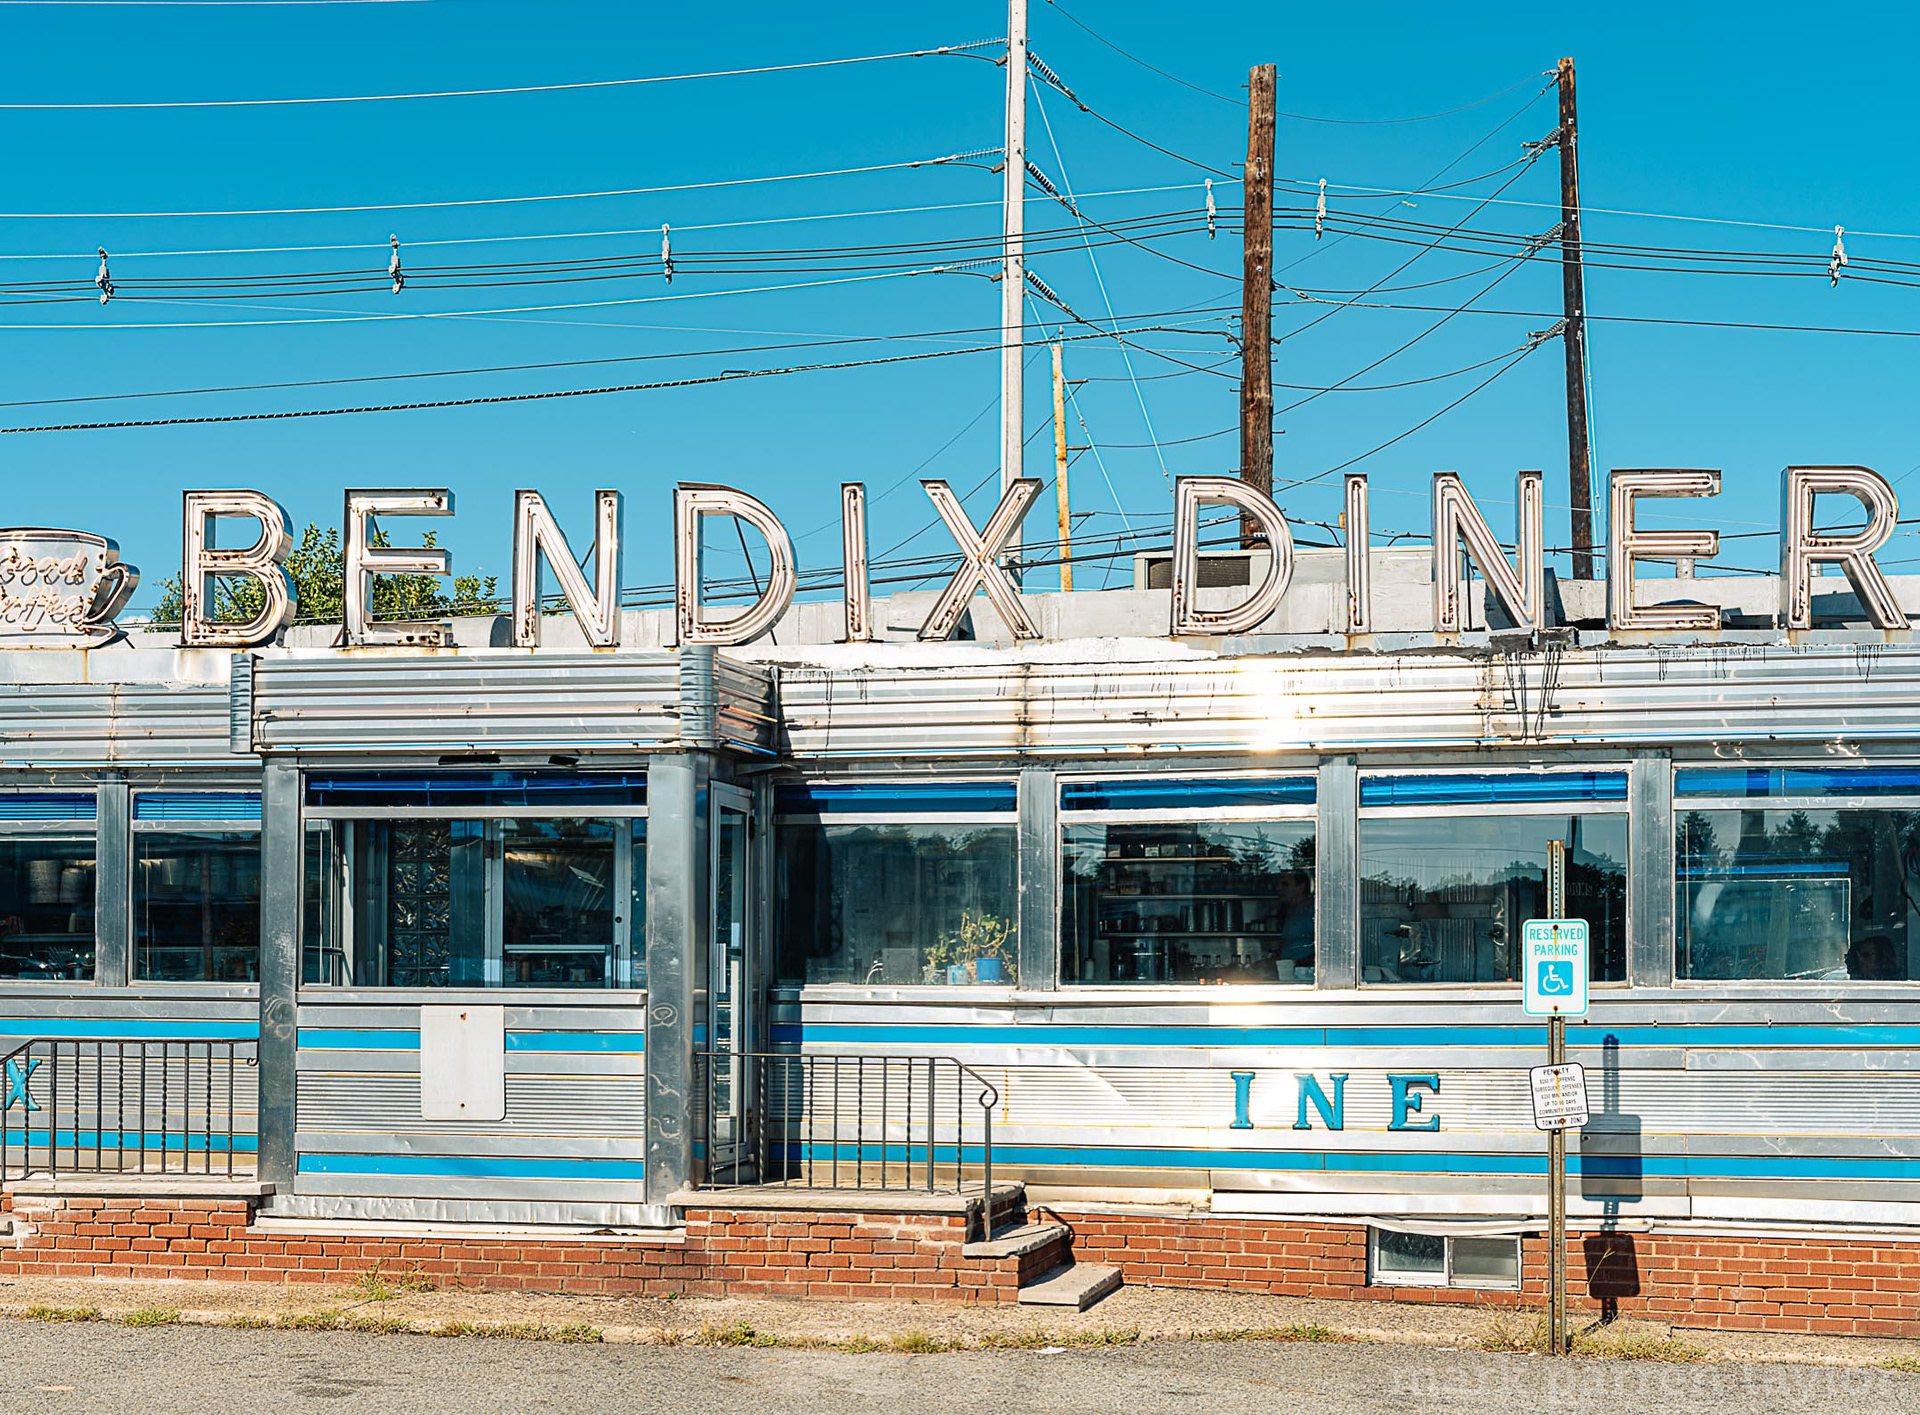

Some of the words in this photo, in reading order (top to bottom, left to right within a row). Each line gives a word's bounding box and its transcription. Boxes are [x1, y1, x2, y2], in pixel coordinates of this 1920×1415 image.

[182, 478, 1043, 647] BENDIX
[1172, 465, 1911, 636] DINER
[1529, 928, 1584, 940] RESERVED
[1534, 944, 1578, 956] PARKING
[1543, 1067, 1569, 1076] PENLTY
